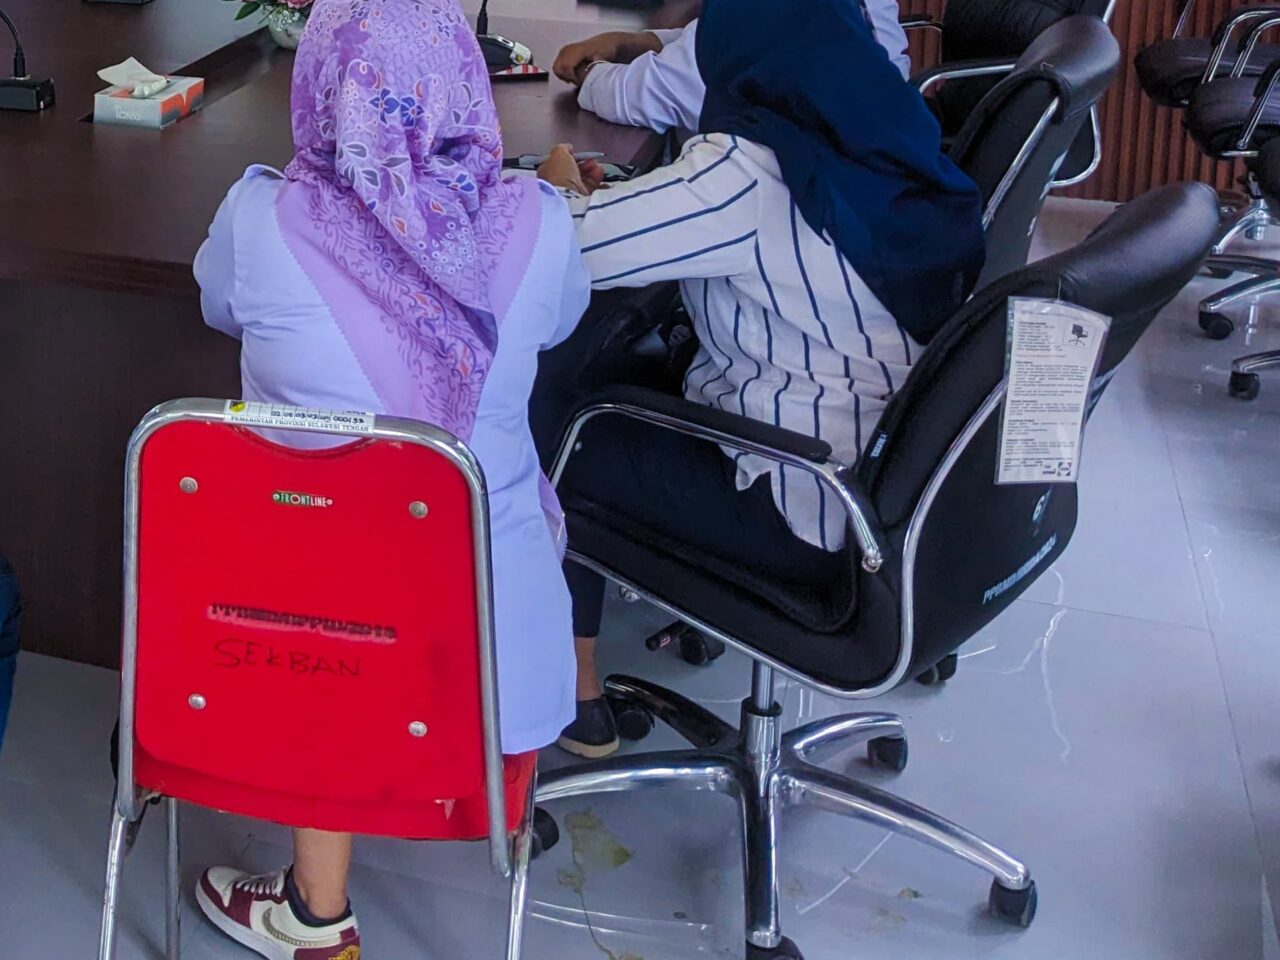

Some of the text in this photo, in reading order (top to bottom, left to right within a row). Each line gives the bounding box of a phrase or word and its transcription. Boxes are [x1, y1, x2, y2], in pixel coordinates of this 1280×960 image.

[275, 419, 306, 427] PROVINSI
[308, 421, 340, 429] SULAWESI
[342, 424, 369, 432] TENGAH
[281, 492, 327, 507] FRONTLINE
